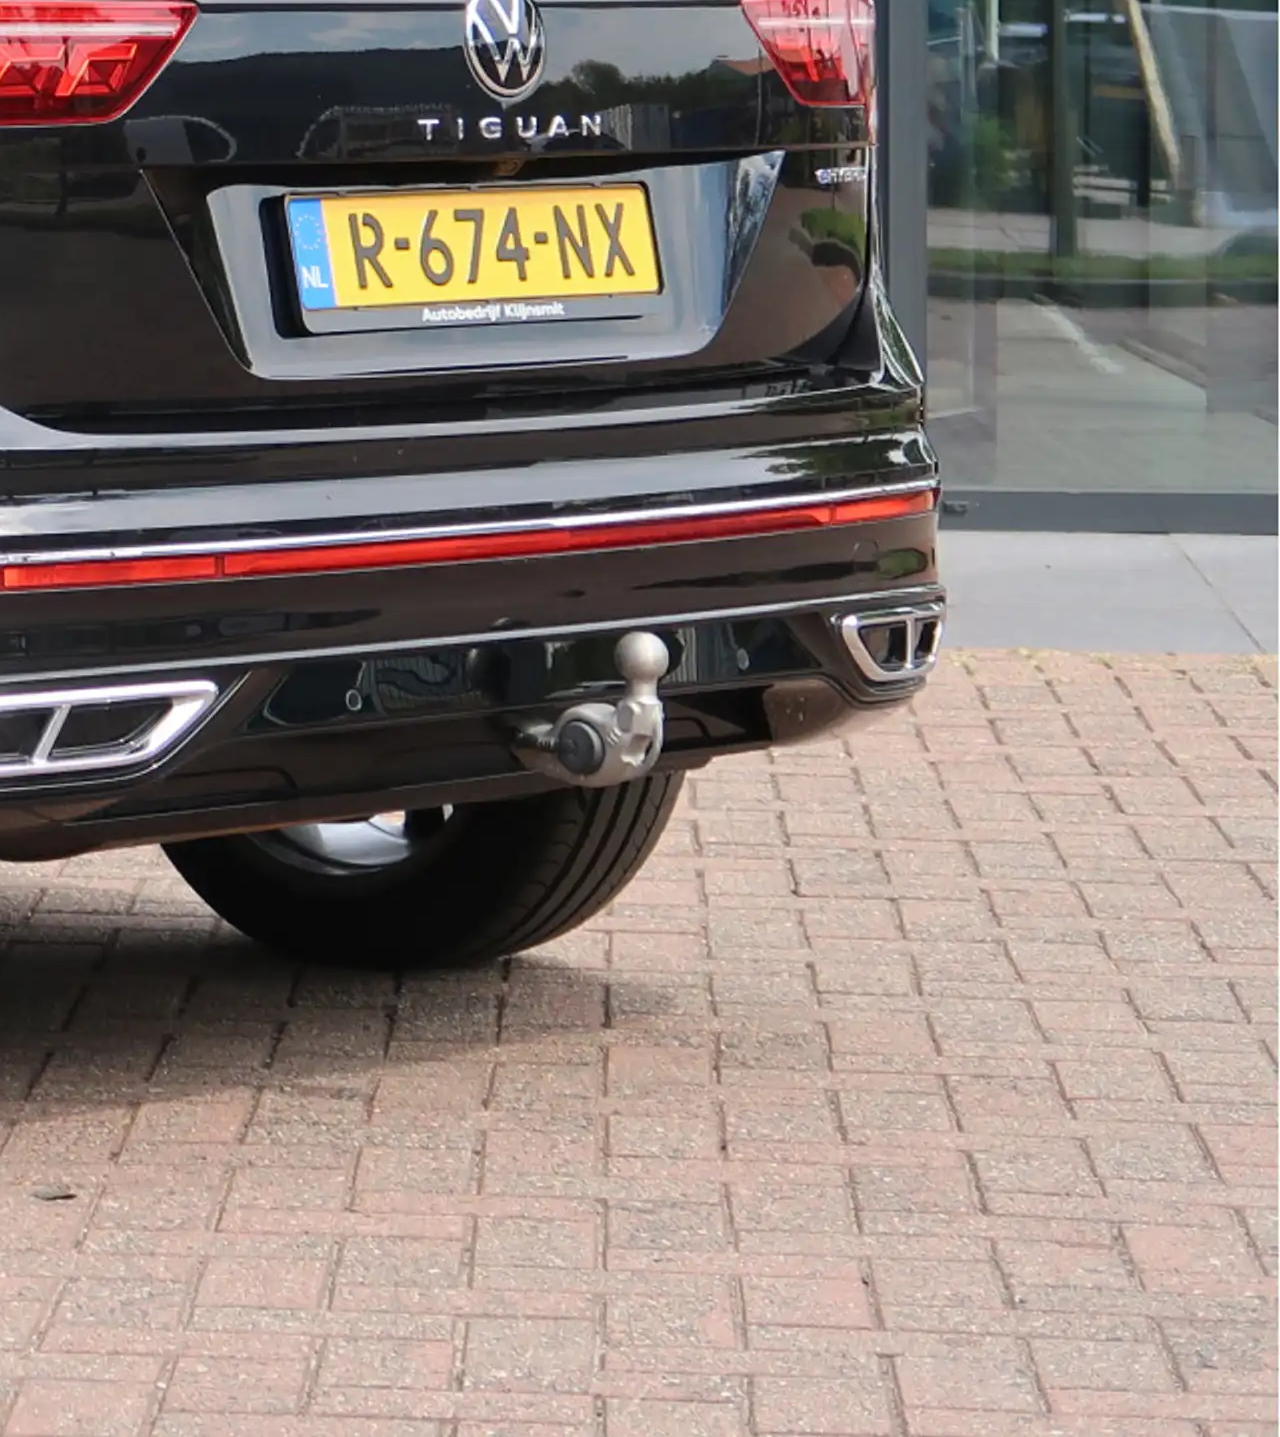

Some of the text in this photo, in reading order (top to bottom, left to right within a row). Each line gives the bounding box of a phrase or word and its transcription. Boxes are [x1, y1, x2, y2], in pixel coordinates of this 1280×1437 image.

[416, 114, 603, 142] TIGUAN
[348, 202, 636, 291] R-674-NX
[301, 264, 329, 290] NL
